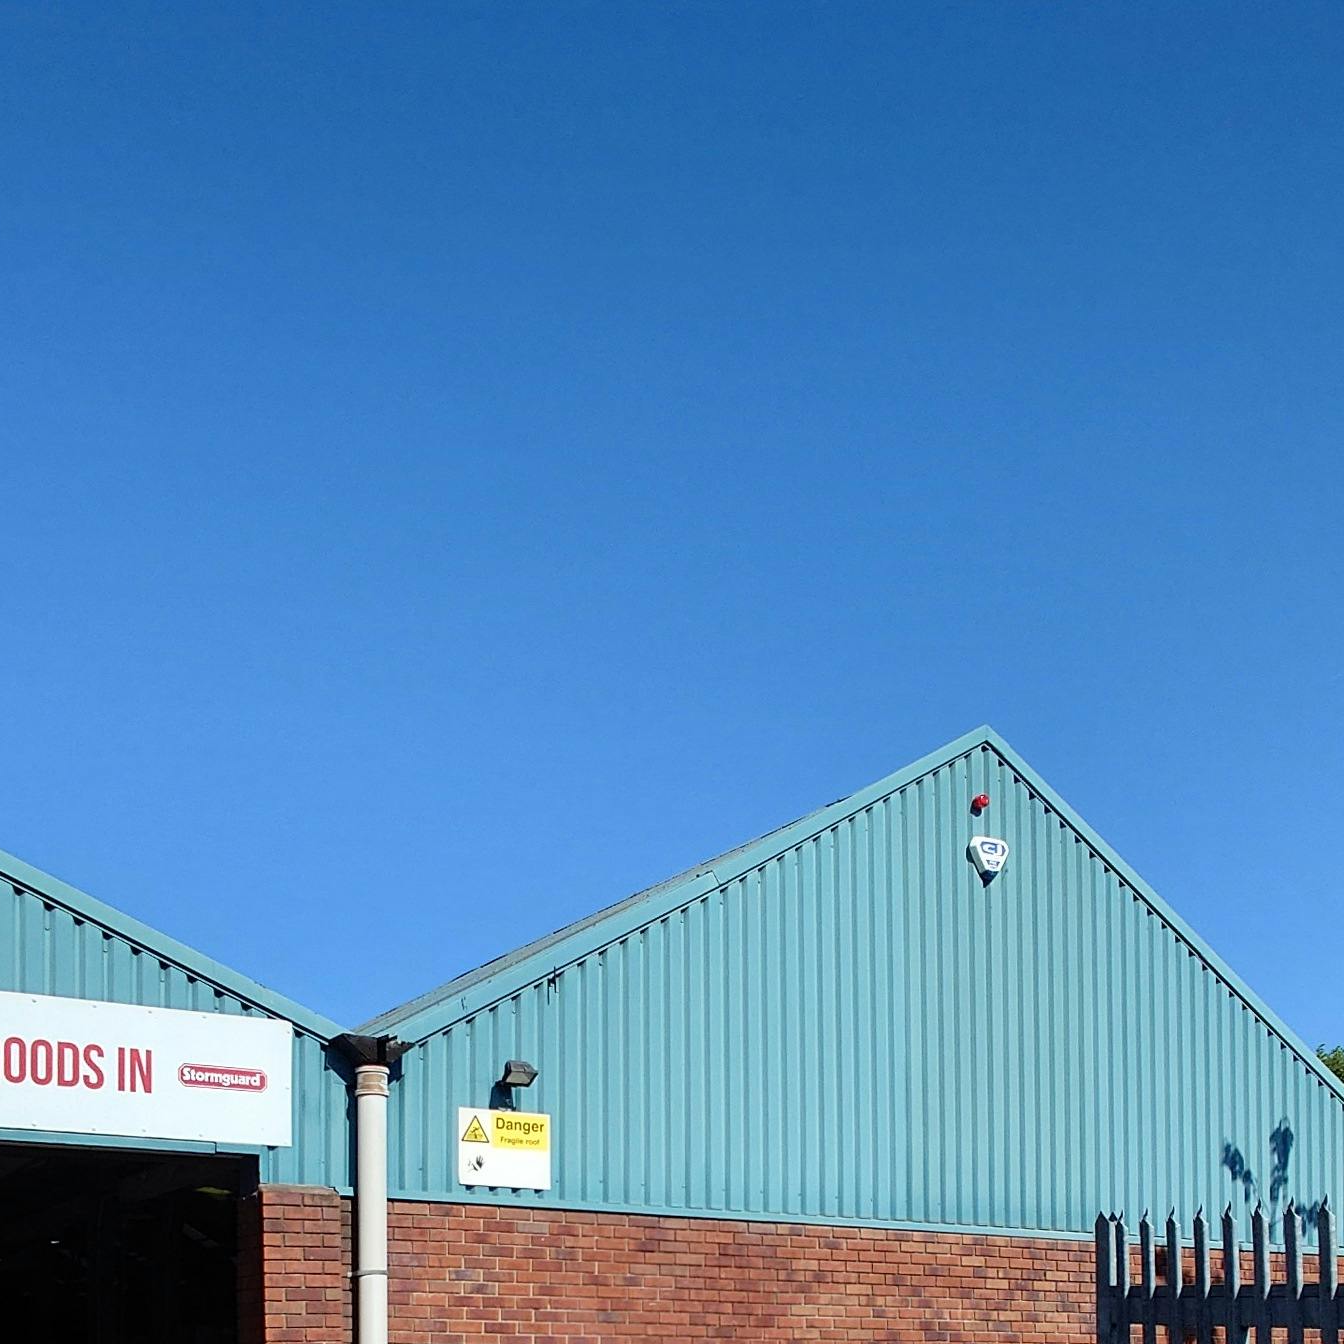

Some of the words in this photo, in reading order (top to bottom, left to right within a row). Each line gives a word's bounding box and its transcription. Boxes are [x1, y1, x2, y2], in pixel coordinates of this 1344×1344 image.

[117, 1047, 153, 1093] IN
[181, 1066, 262, 1087] Stormguard
[495, 1117, 545, 1135] Danger
[500, 1136, 523, 1145] Fragile
